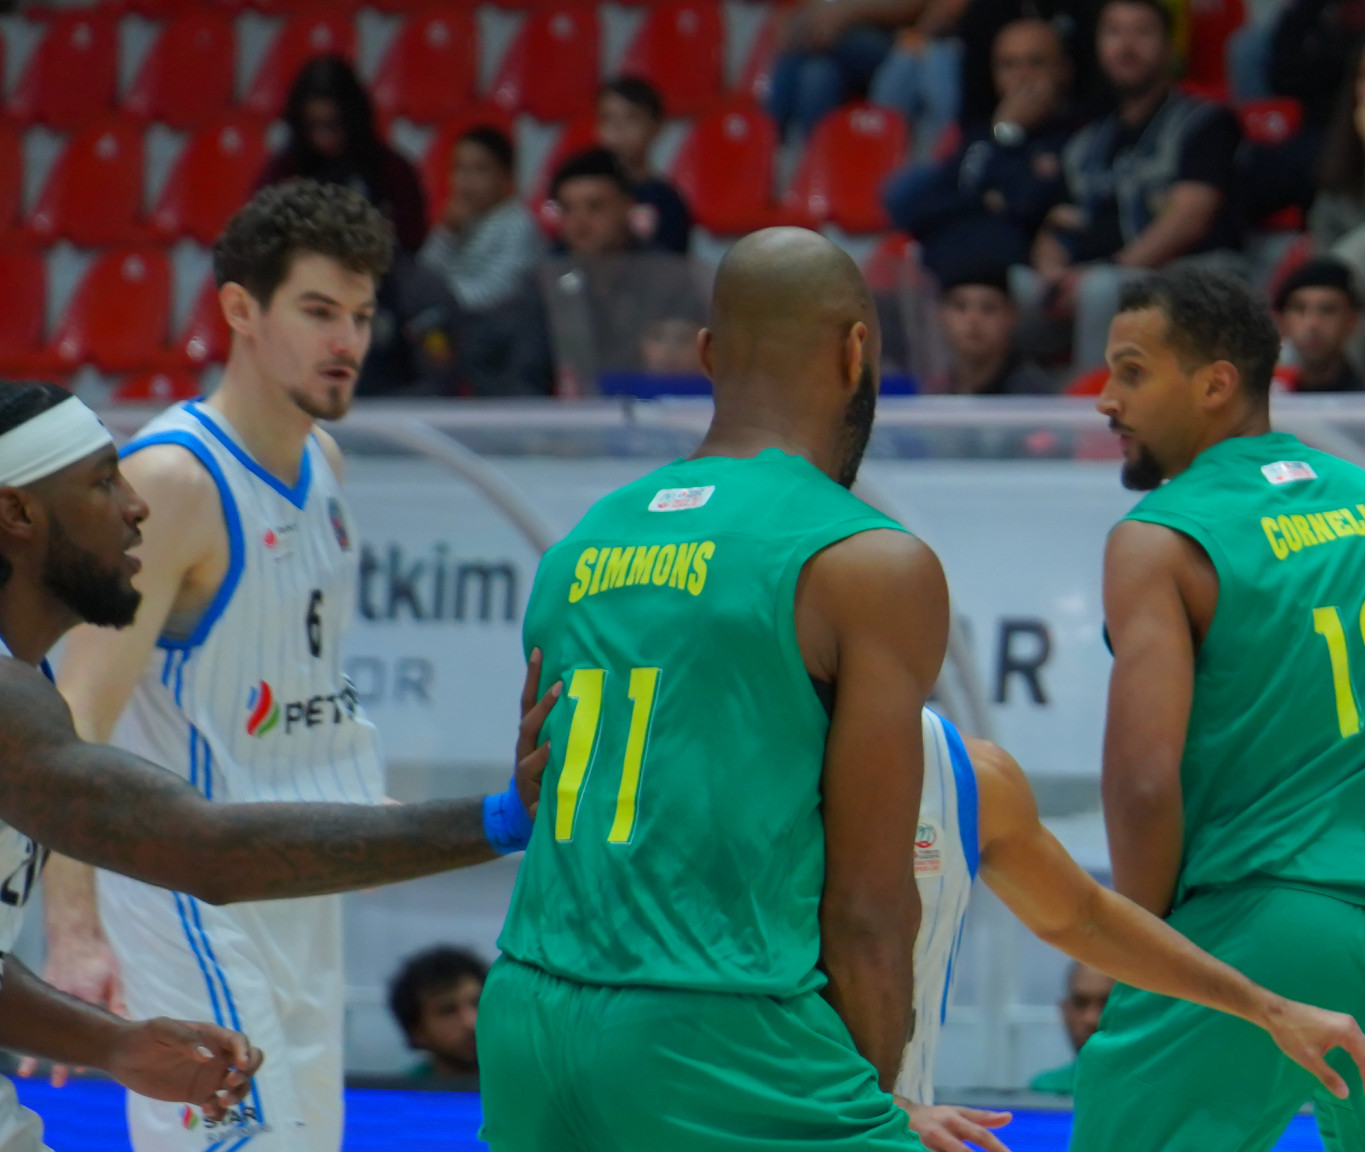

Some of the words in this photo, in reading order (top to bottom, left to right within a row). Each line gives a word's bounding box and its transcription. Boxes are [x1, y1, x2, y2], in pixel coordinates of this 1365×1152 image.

[358, 543, 516, 623] tkim
[568, 540, 716, 604] SIMMONS
[306, 588, 323, 659] 6
[555, 667, 663, 845] 11
